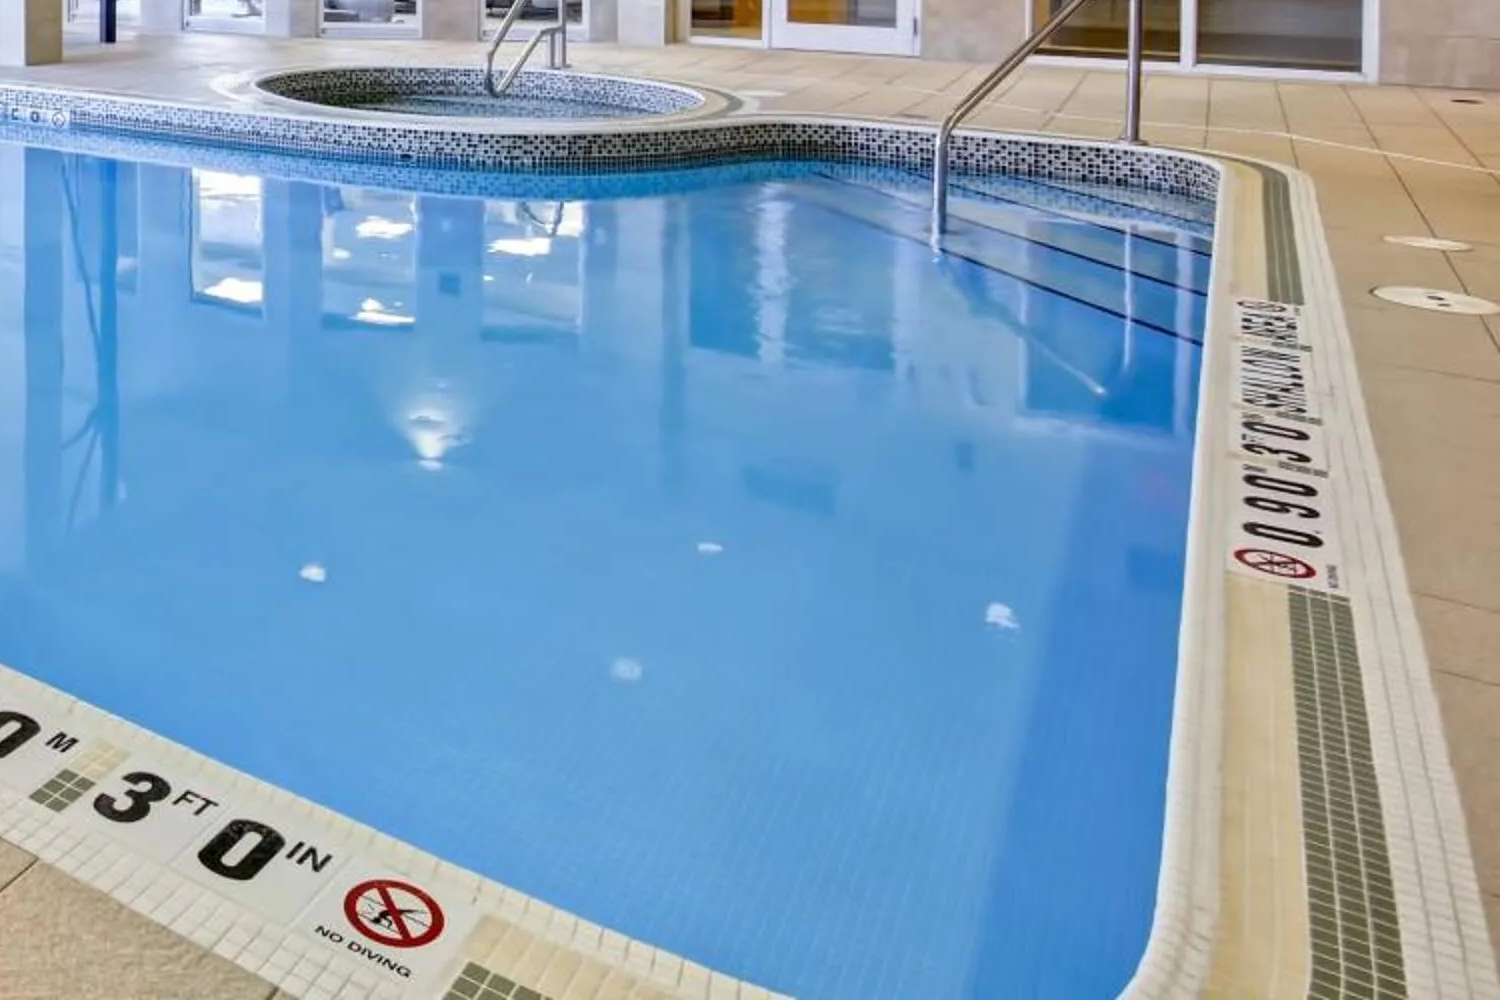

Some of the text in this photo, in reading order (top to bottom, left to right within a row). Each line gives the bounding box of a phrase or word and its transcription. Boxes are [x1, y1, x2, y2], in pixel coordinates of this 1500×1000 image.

[1242, 443, 1312, 463] 3
[45, 731, 80, 754] M
[93, 771, 171, 823] 3
[172, 789, 219, 817] FT
[197, 818, 286, 881] 0
[285, 841, 333, 873] IN
[314, 925, 412, 978] NO DIVING
